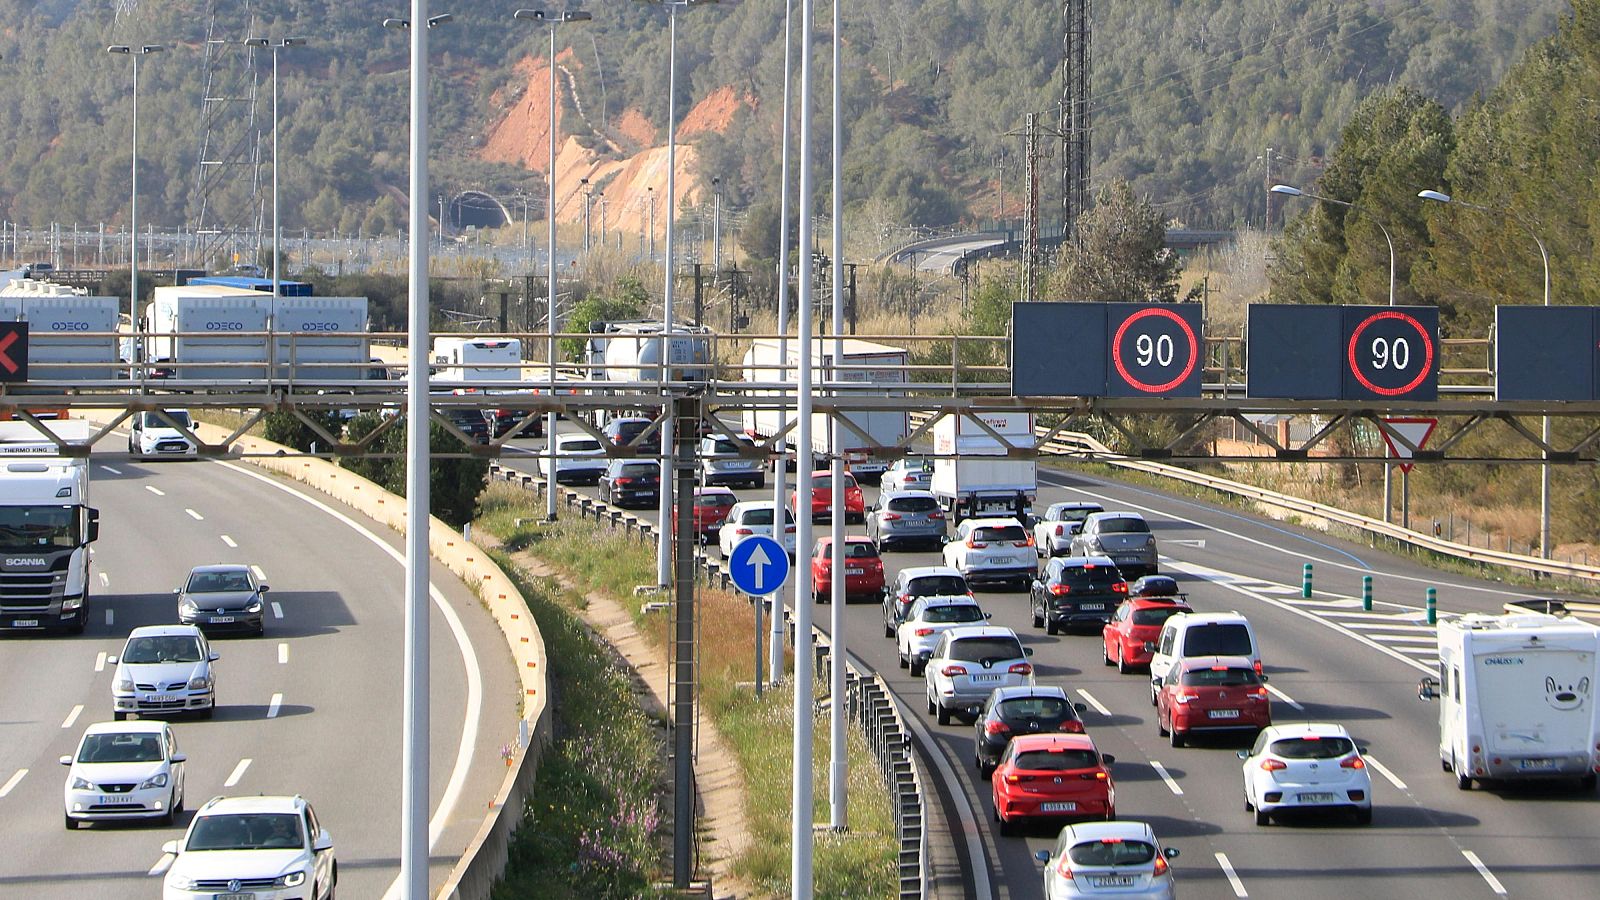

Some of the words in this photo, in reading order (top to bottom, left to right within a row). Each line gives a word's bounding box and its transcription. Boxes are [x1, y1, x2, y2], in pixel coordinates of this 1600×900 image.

[52, 321, 89, 331] ODECO
[206, 321, 243, 331] ODECO
[302, 322, 339, 331] ODECO
[1136, 334, 1173, 367] 90
[1372, 337, 1409, 370] 90
[5, 558, 46, 566] SCANIA
